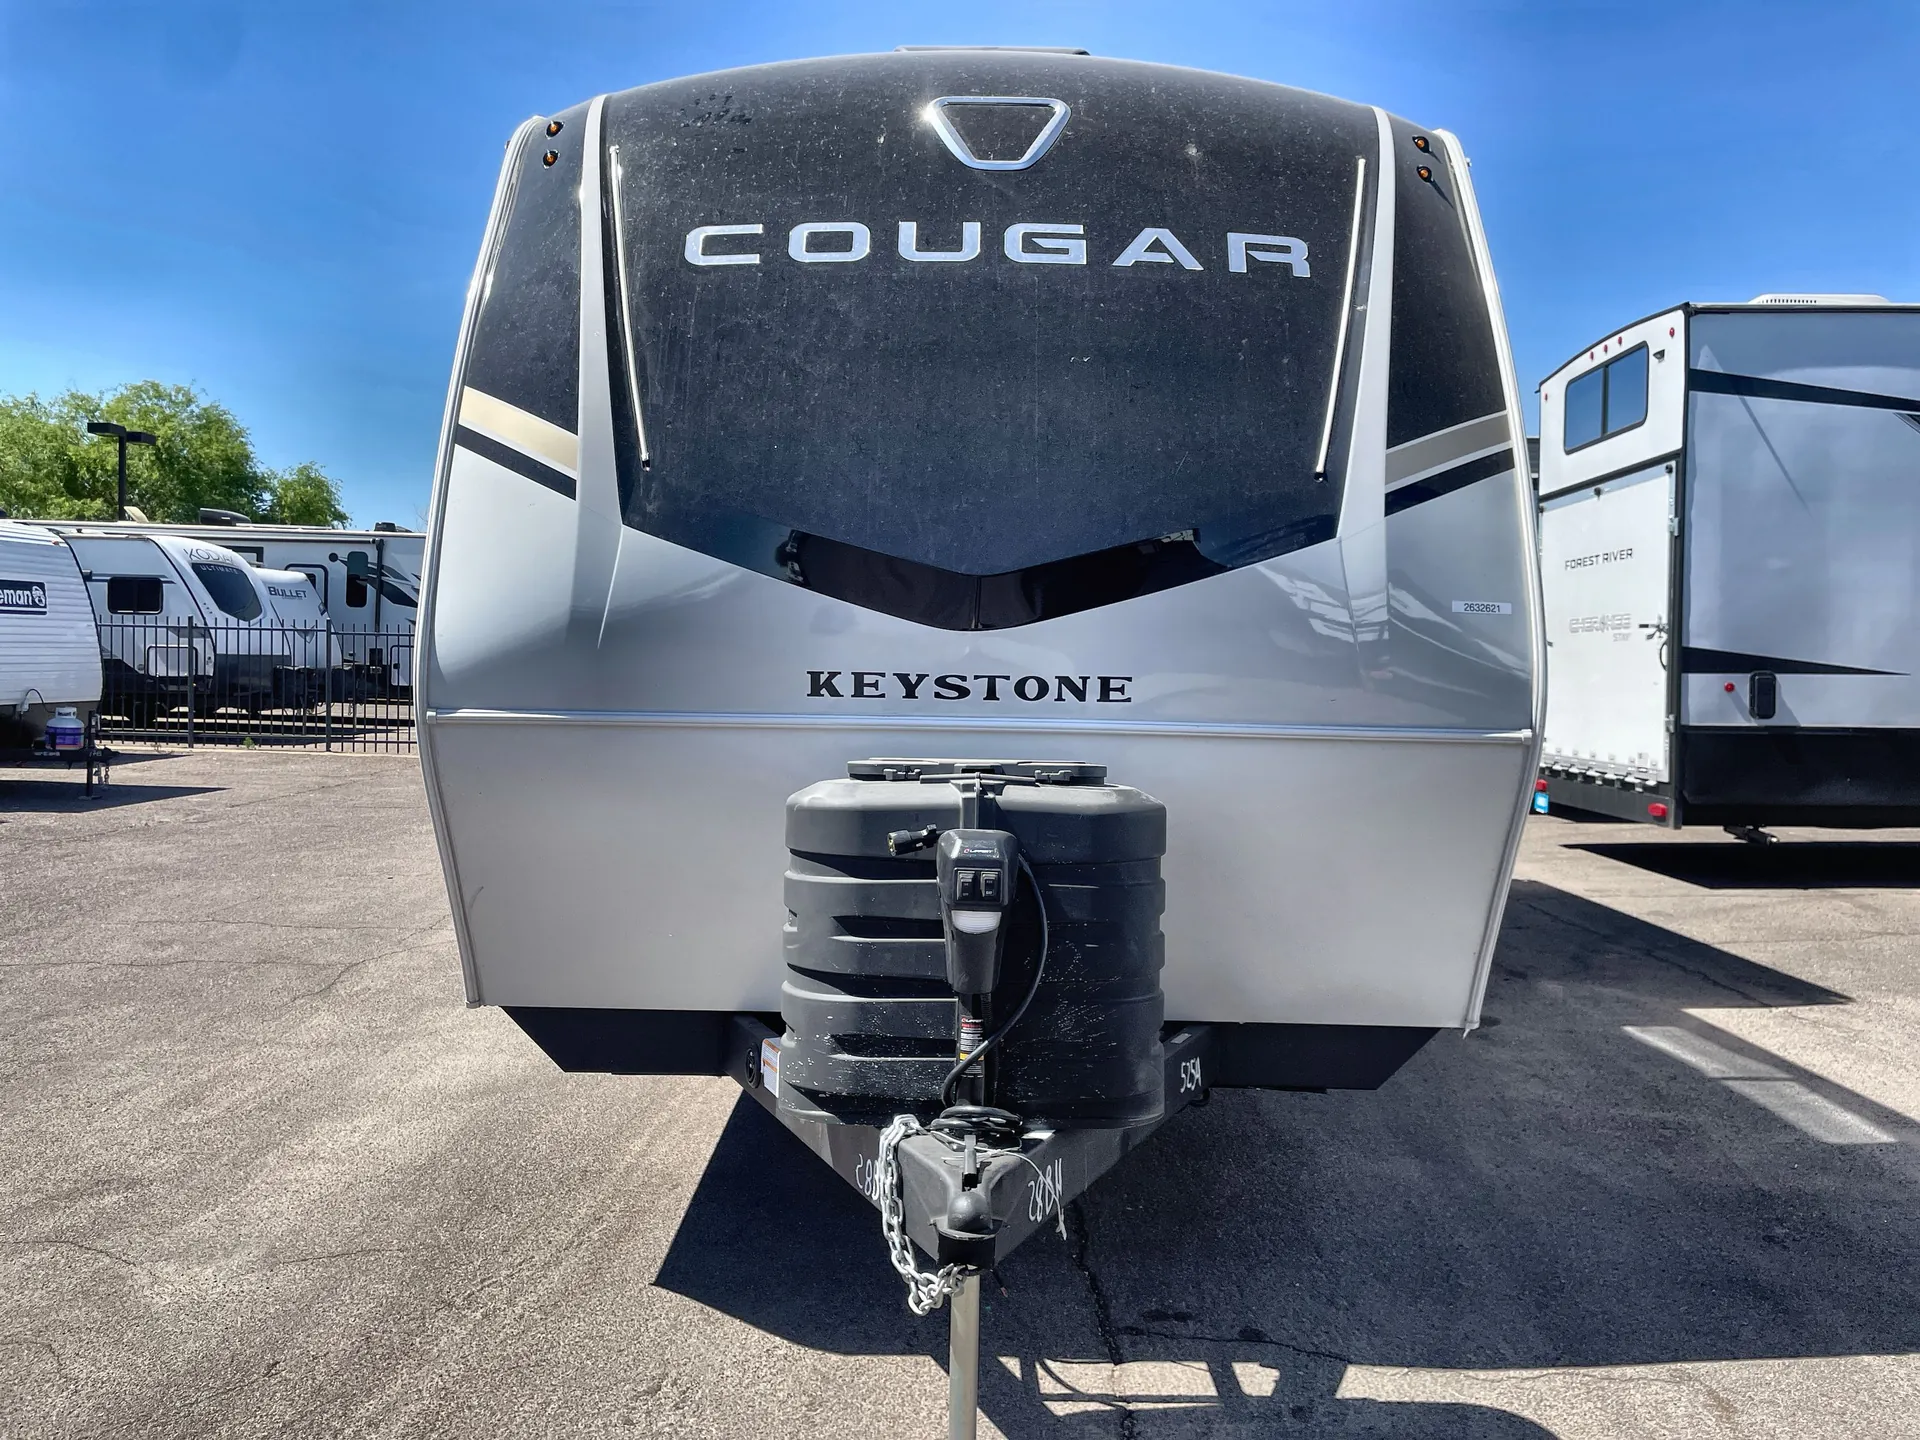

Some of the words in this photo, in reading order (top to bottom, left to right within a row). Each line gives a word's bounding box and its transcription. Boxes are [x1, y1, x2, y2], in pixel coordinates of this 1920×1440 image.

[684, 220, 1311, 278] COUGAR
[1564, 554, 1600, 571] FOREST
[1602, 548, 1634, 564] RIVER
[267, 586, 307, 599] BULLET
[1463, 602, 1501, 613] 2632621
[806, 669, 1134, 703] KEYSTONE
